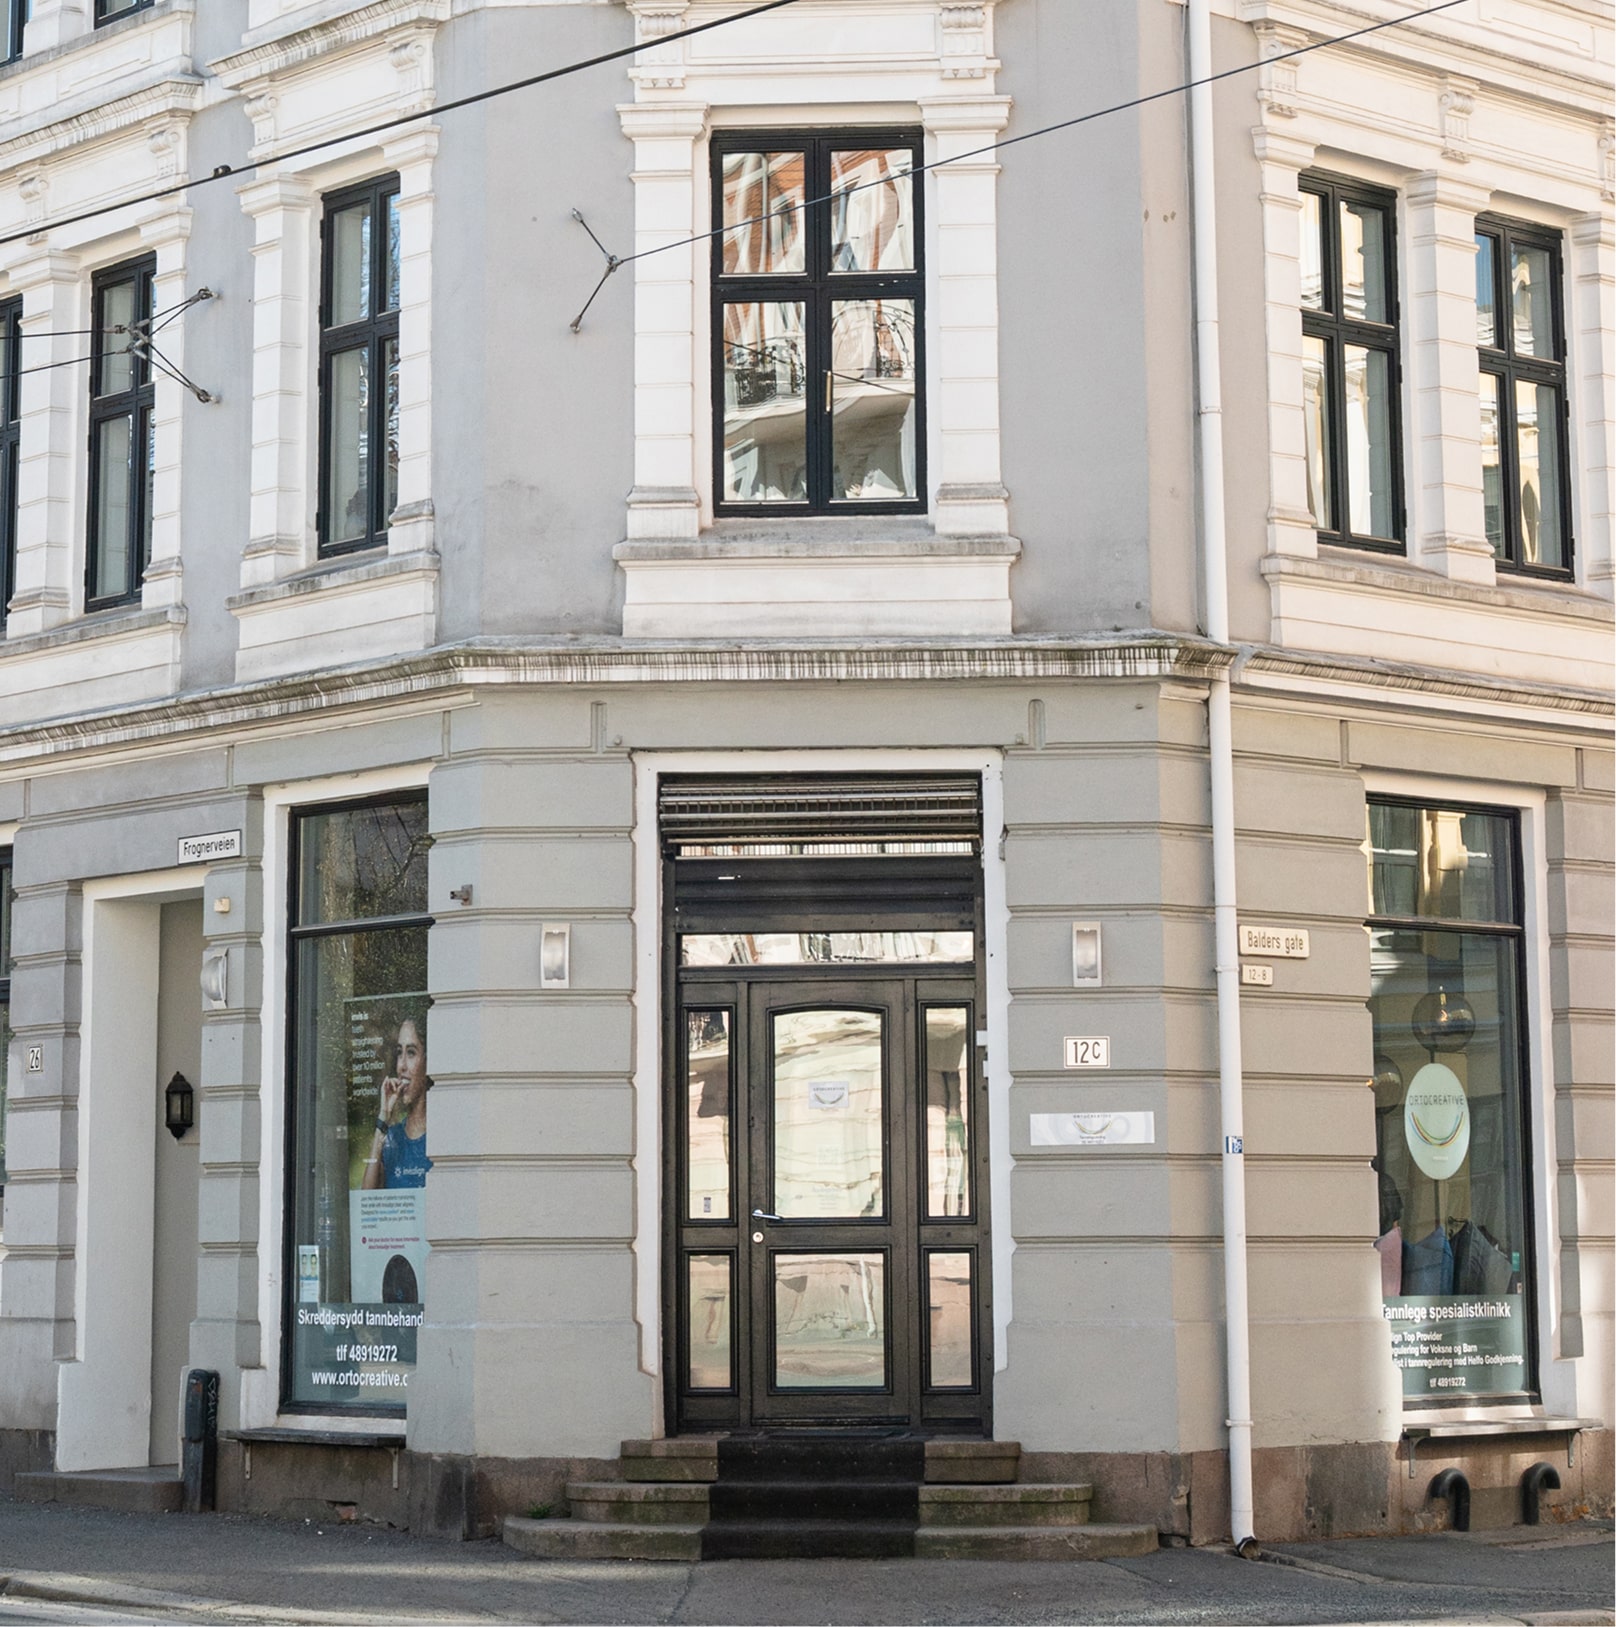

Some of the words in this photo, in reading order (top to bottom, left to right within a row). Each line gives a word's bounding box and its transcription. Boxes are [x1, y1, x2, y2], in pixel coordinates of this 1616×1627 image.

[183, 837, 235, 857] Frognerveien
[1247, 930, 1281, 949] Balders
[1285, 934, 1304, 954] gate
[30, 1049, 40, 1069] 26
[1409, 1094, 1465, 1106] ORTOCREATIVE
[298, 1309, 364, 1329] Skreddersydd
[366, 1311, 424, 1327] tannbehand
[1429, 1301, 1511, 1322] spesialistklinikk
[1403, 1331, 1416, 1344] Top
[1416, 1331, 1443, 1342] Provider
[336, 1344, 348, 1361] tlf
[349, 1345, 398, 1362] 48919272
[1420, 1344, 1430, 1354] for
[1453, 1345, 1462, 1355] og
[1462, 1343, 1478, 1353] Barn
[1437, 1376, 1466, 1388] 48919272
